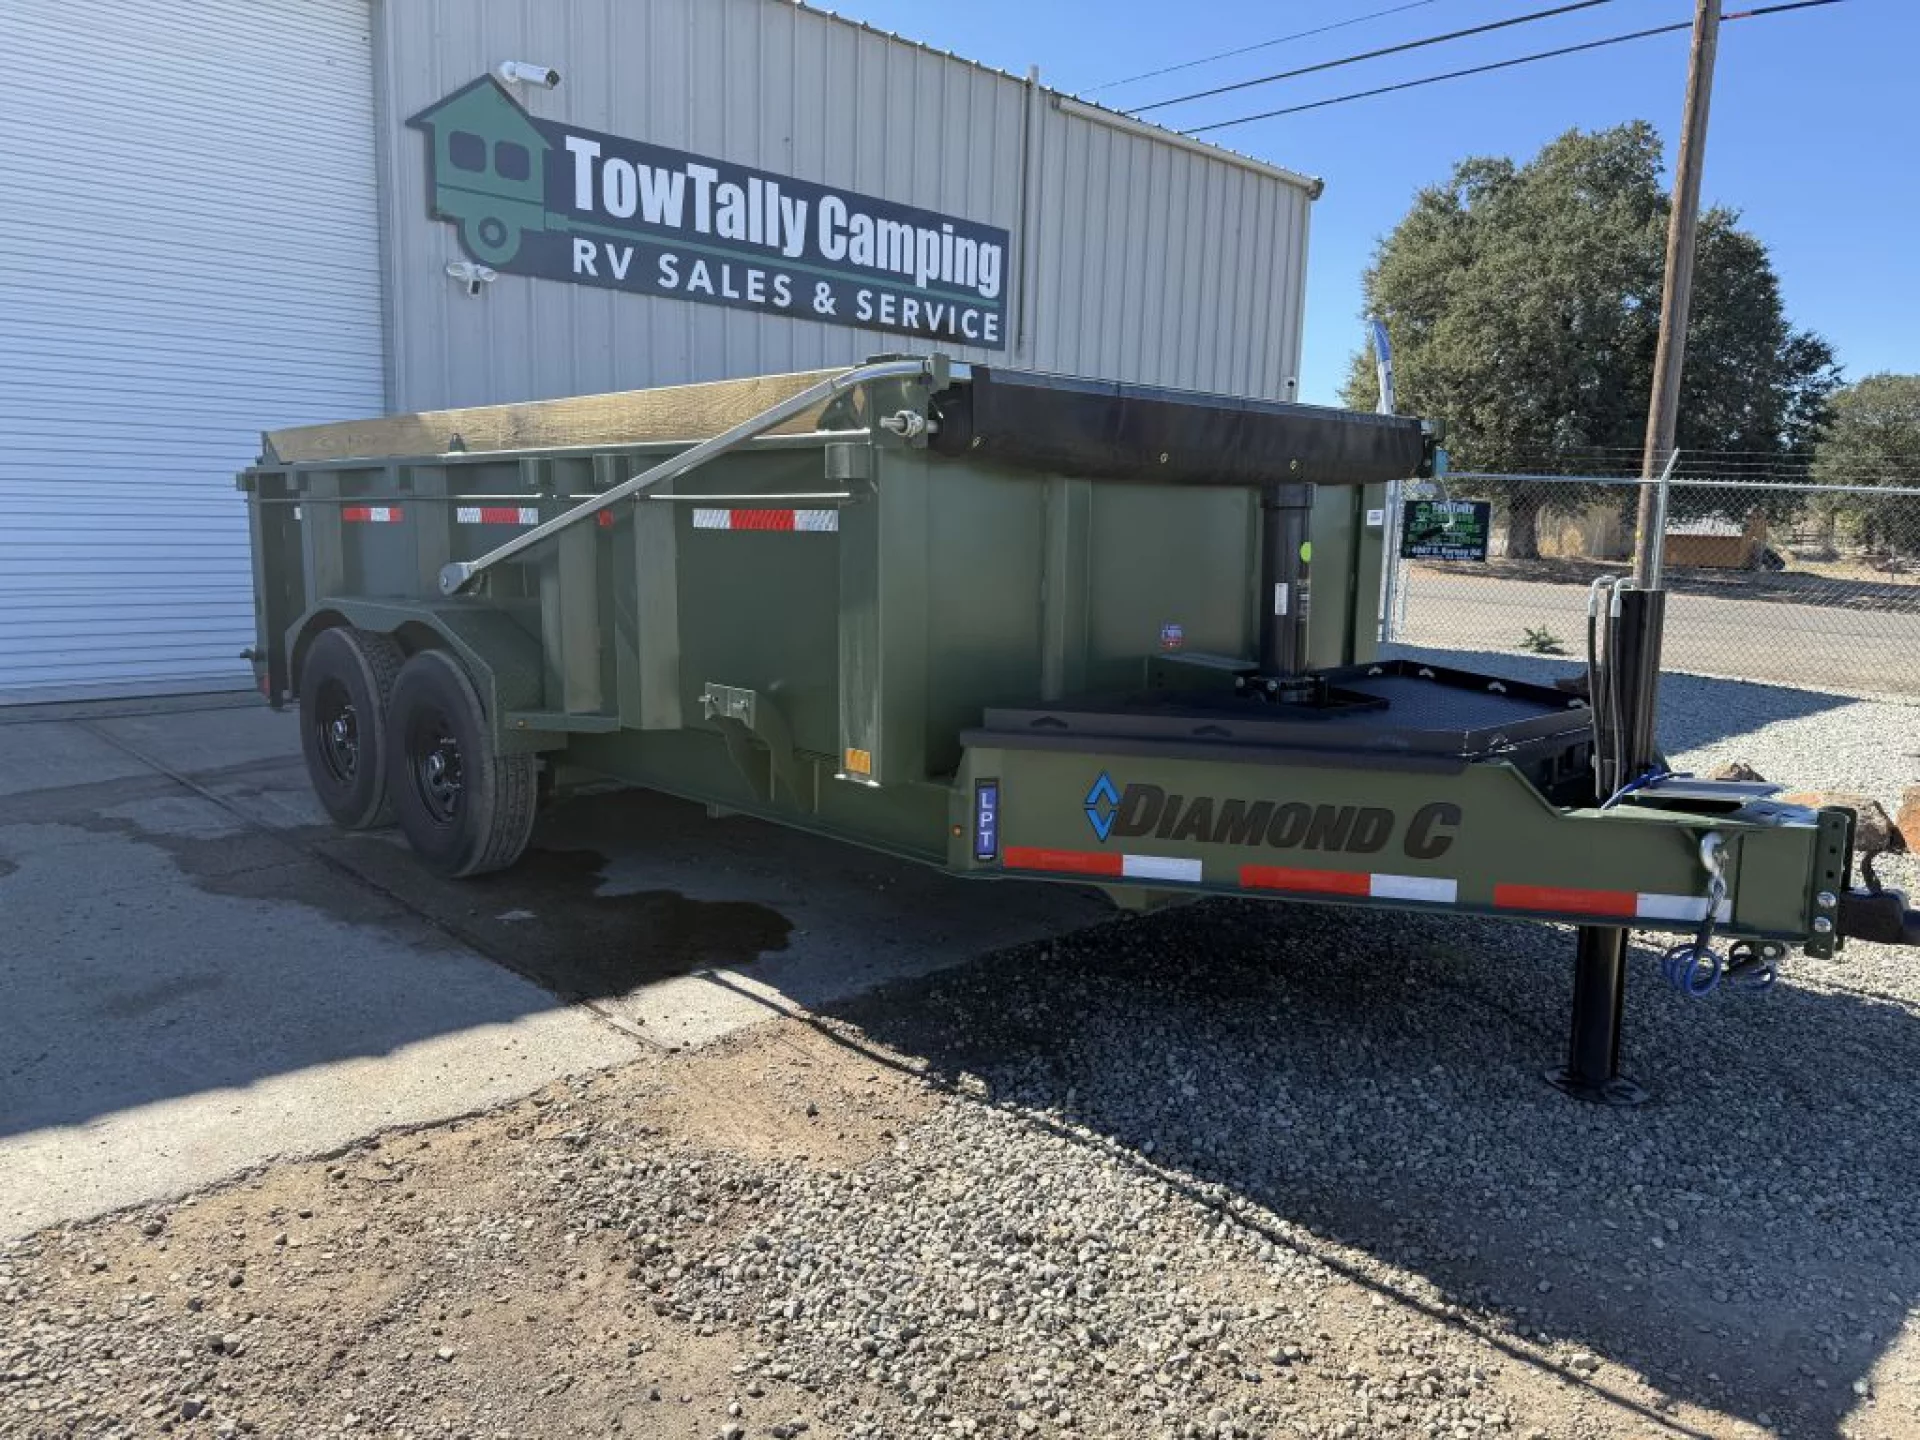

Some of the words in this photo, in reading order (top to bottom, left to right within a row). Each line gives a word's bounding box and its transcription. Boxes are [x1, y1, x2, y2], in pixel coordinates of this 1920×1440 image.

[566, 134, 808, 258] TowTally
[819, 195, 1001, 298] Camping
[573, 237, 634, 280] RV
[658, 253, 792, 307] SALES
[814, 281, 836, 315] &
[857, 289, 998, 341] SERVICE
[980, 792, 993, 848] LPT
[1112, 783, 1394, 854] DIAMOND
[1404, 802, 1462, 859] C
